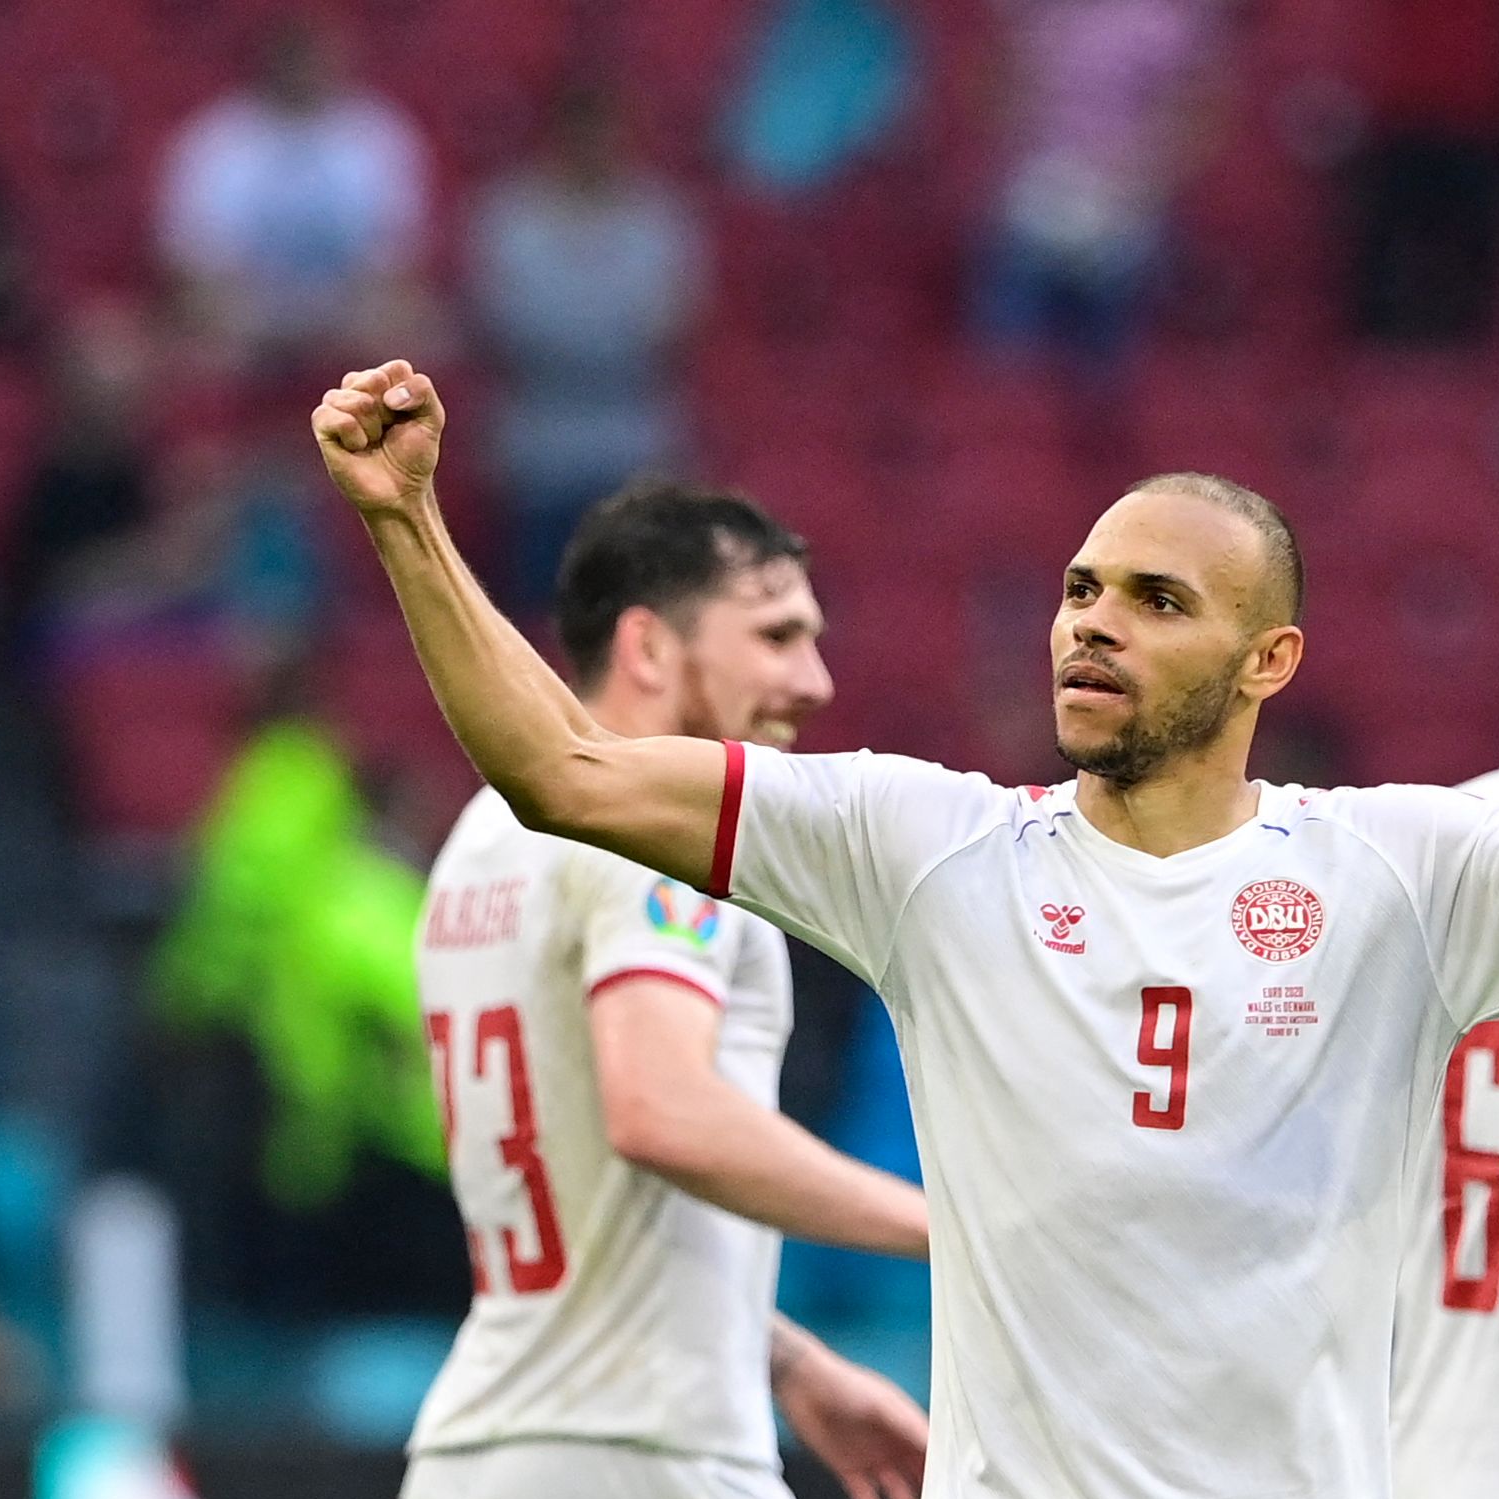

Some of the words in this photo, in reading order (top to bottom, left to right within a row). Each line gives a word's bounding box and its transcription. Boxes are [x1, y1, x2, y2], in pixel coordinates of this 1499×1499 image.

[1248, 904, 1307, 931] DBU
[1302, 901, 1323, 948] UNION
[1262, 947, 1301, 961] 1889
[1248, 1001, 1273, 1013] WALES
[1283, 1001, 1315, 1012] DENMARK
[1132, 986, 1193, 1131] 9
